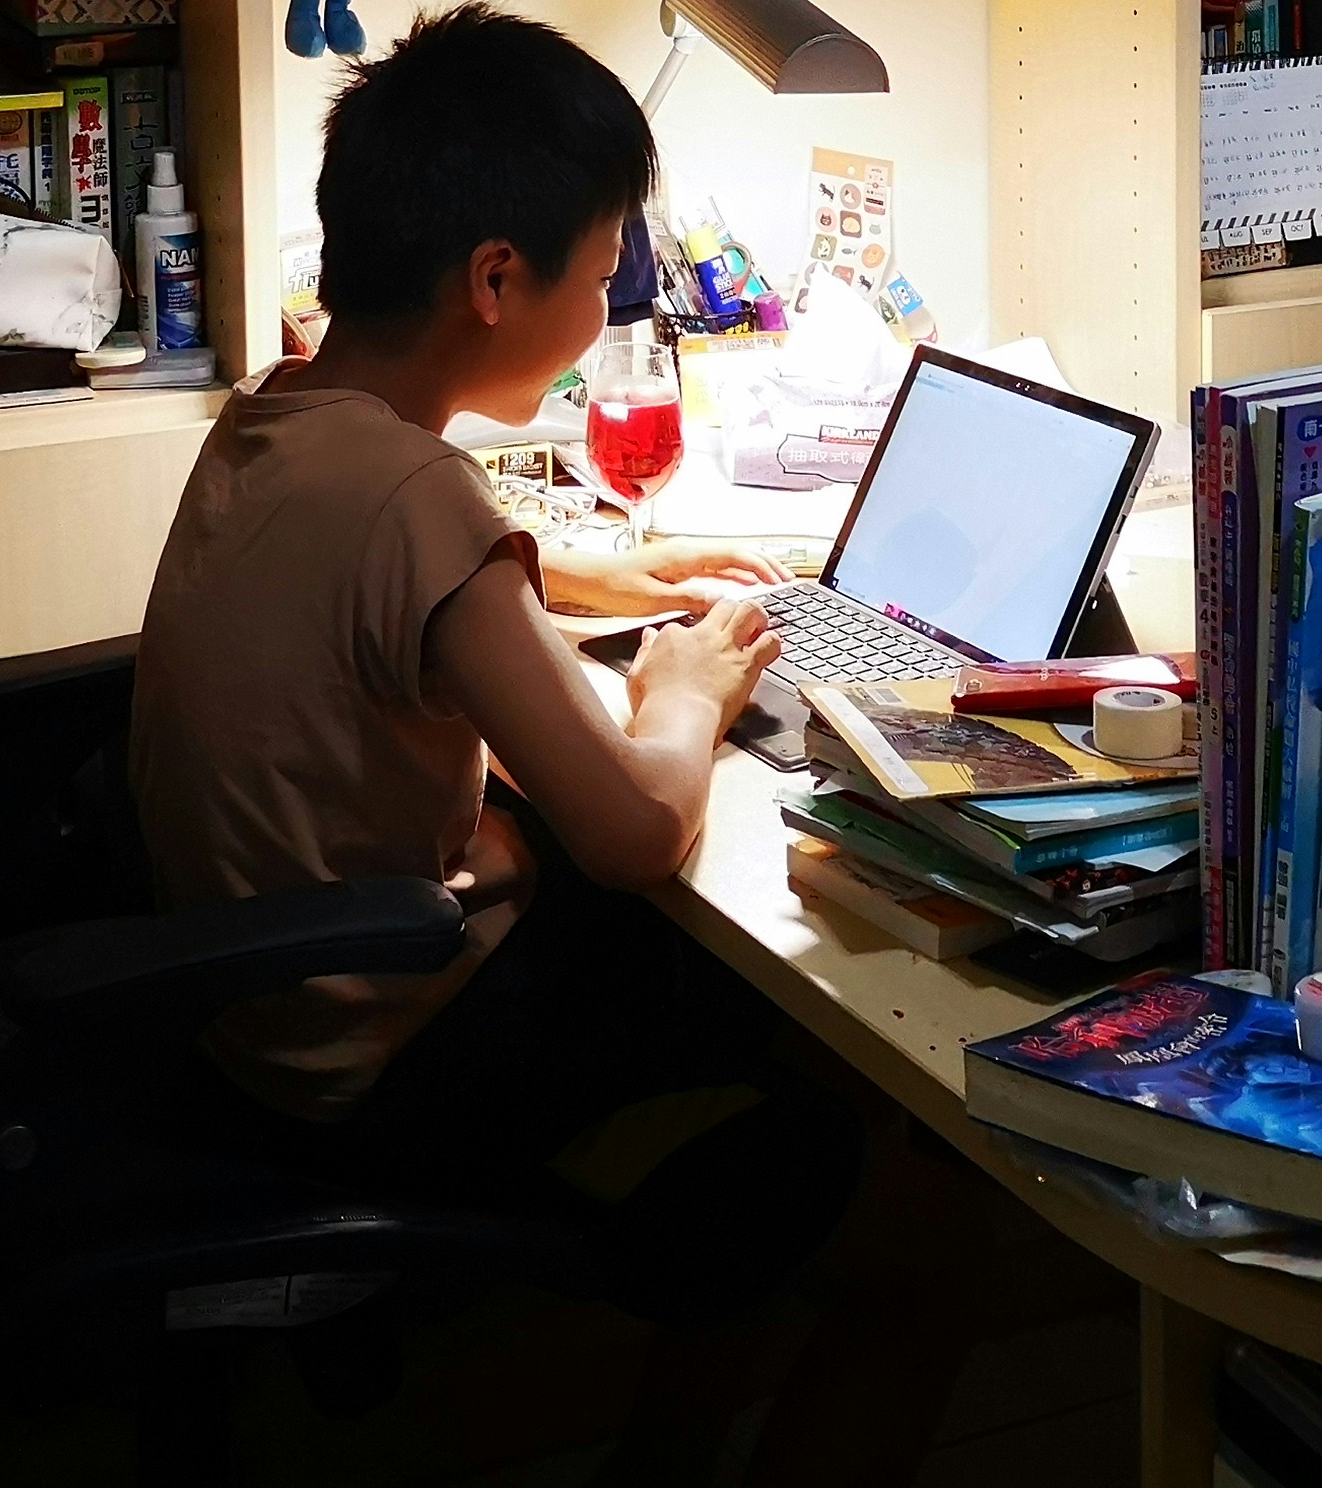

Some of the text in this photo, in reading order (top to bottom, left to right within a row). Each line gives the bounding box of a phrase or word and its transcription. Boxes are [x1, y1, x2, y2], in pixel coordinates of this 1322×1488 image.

[92, 137, 108, 189] 魔法師
[502, 452, 535, 466] 1209
